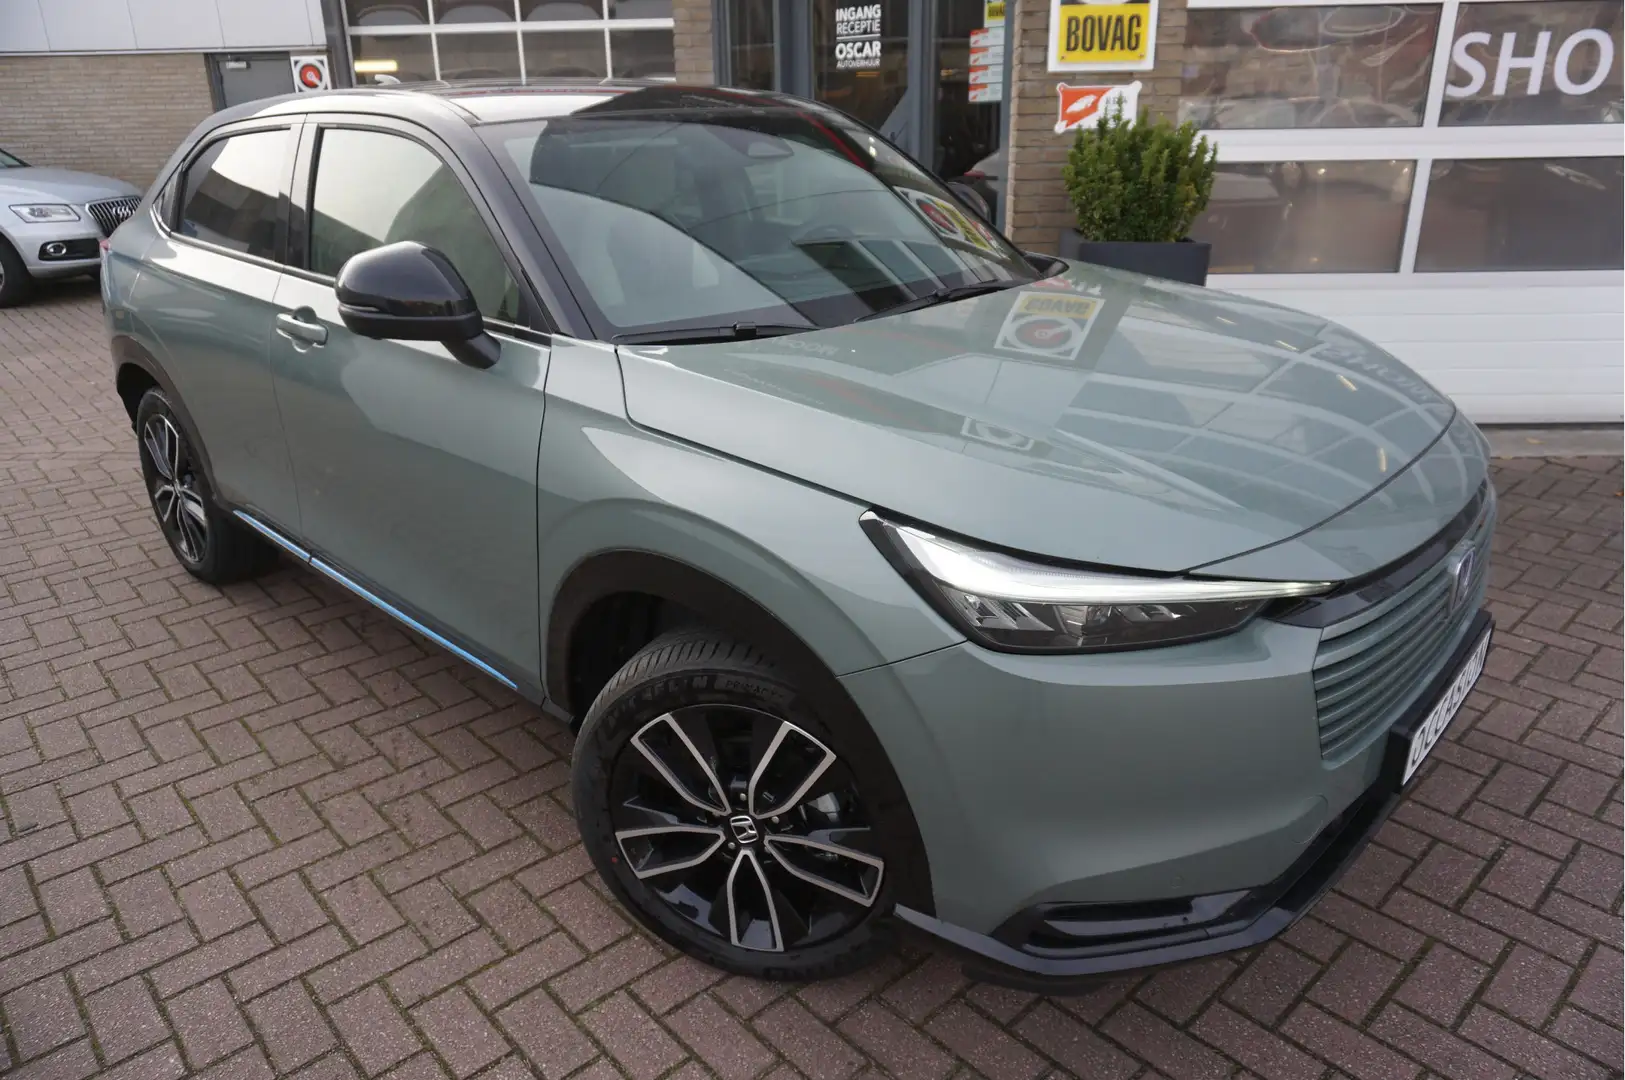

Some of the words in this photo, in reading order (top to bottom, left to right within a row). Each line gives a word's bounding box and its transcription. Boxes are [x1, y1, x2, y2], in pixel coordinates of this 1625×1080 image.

[836, 4, 881, 22] INGANG
[836, 19, 881, 34] RECEPTIE
[1066, 13, 1141, 52] BOVAG
[835, 41, 881, 59] OSCAR
[1445, 28, 1614, 98] SHO
